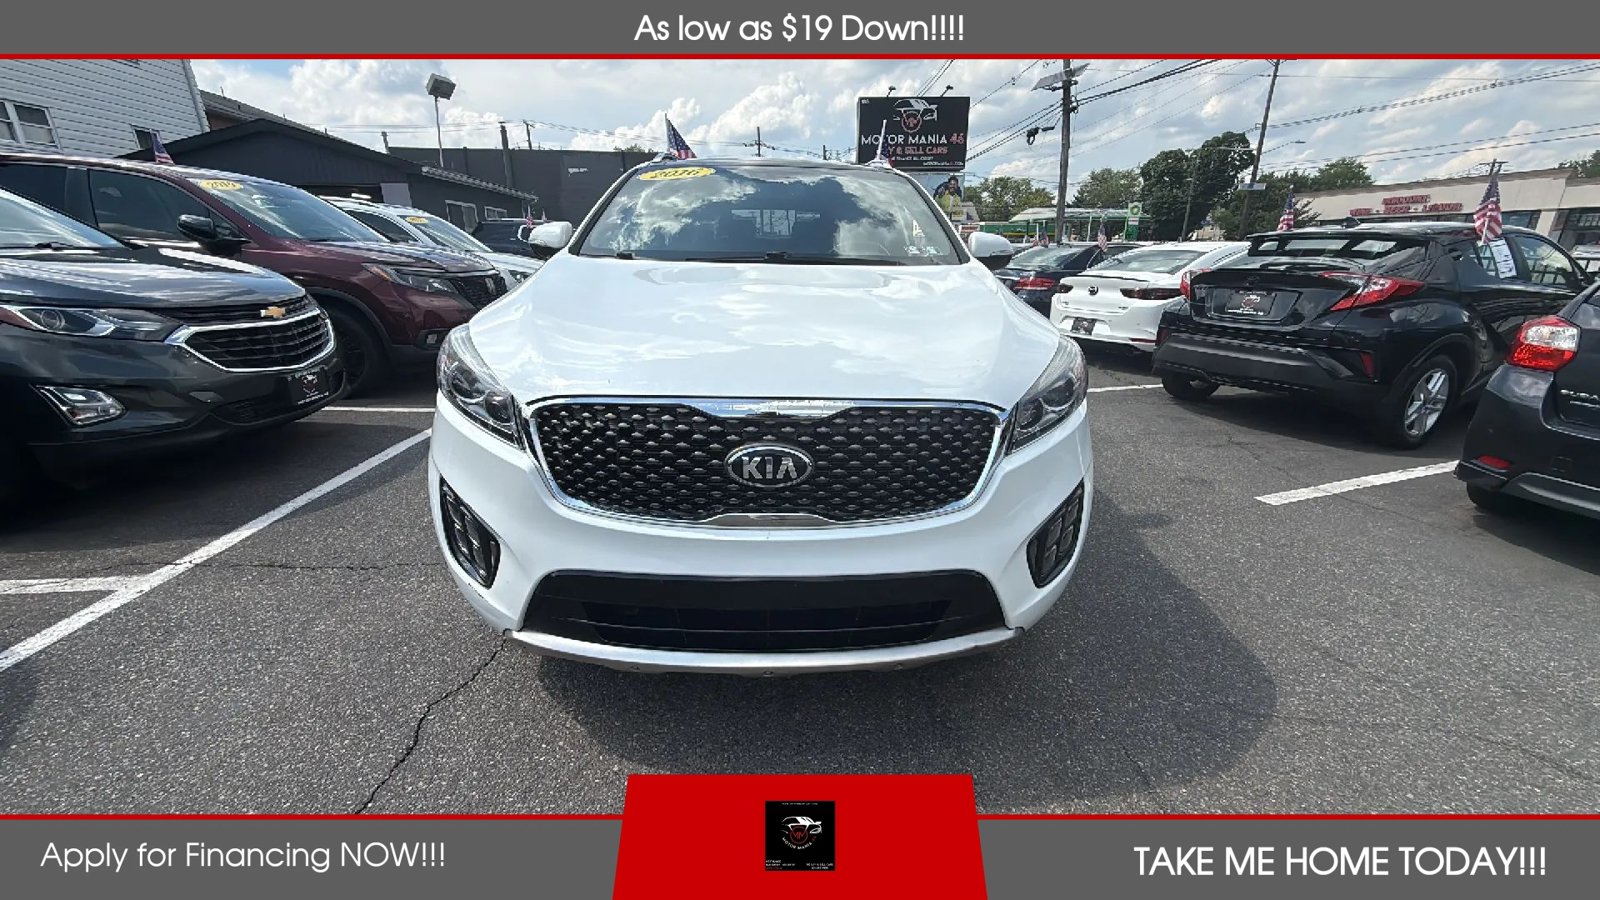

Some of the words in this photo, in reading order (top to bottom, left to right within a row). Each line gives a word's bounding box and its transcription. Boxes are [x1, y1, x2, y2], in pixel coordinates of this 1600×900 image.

[908, 133, 948, 144] MANIA
[904, 146, 924, 154] SELL
[926, 146, 948, 154] CARS
[741, 456, 798, 479] KIA
